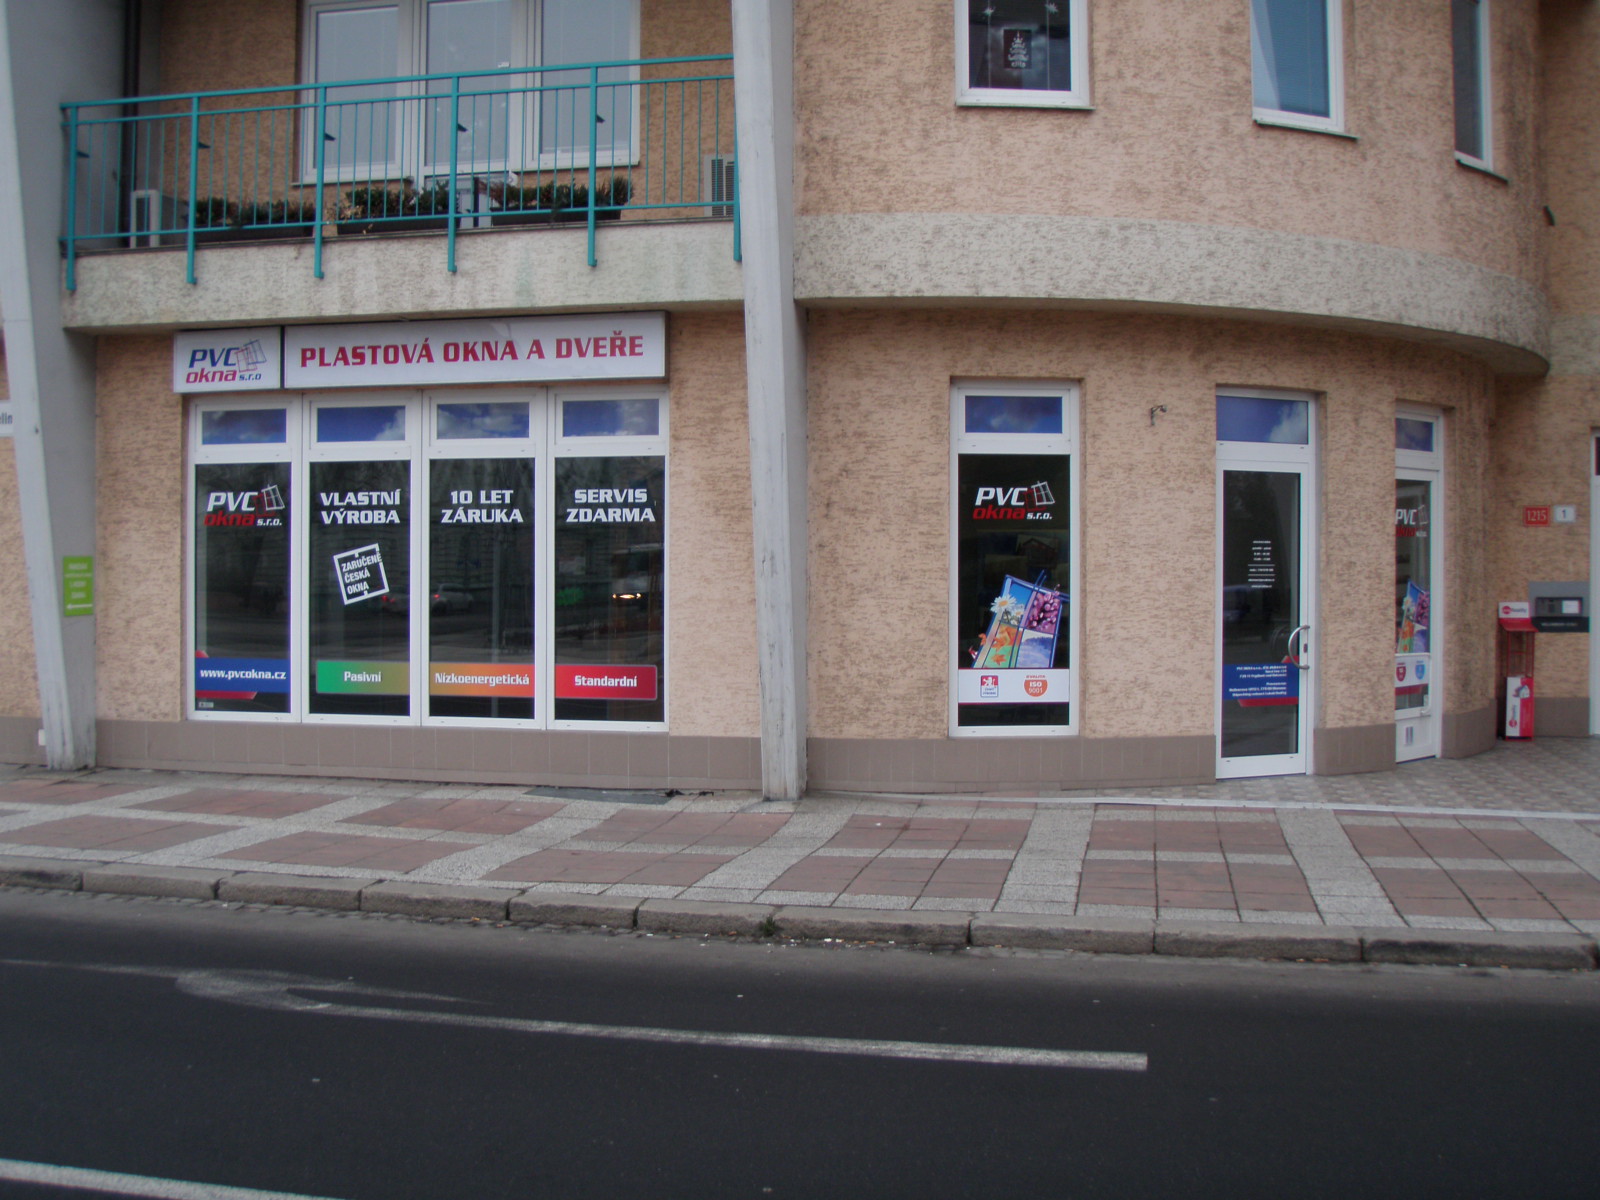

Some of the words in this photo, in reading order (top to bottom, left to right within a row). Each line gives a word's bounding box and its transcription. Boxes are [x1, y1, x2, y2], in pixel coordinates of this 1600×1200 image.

[300, 338, 435, 368] PLASTOVÁ
[443, 340, 519, 363] OKNA
[526, 338, 546, 360] A
[555, 330, 644, 359] DVEŘE
[188, 346, 241, 369] PVC
[185, 367, 238, 384] okna
[206, 491, 258, 512] PVC
[319, 488, 402, 506] VLASTNÍ
[450, 490, 473, 505] 10
[480, 489, 514, 505] LET
[574, 488, 648, 504] SERVIS
[974, 487, 1028, 506] PVC
[203, 508, 255, 526] okna
[256, 517, 283, 527] s.r.o.
[320, 508, 400, 524] VÝROBA
[440, 506, 524, 523] ZÁRUKA
[565, 507, 656, 523] ZDARMA
[972, 504, 1026, 520] okna
[1026, 511, 1053, 520] s.r.o.
[1395, 508, 1418, 525] PVC
[1526, 509, 1548, 522] 1215
[1561, 509, 1567, 519] 1
[341, 552, 383, 572] ZARUČENĚ
[344, 568, 371, 584] ČESKÁ
[346, 583, 370, 595] OKNA
[199, 668, 287, 680] www.pvcokna.cz
[343, 671, 382, 682] Pasivní
[434, 672, 530, 687] Nízkoenergetická
[574, 675, 638, 688] Standardní
